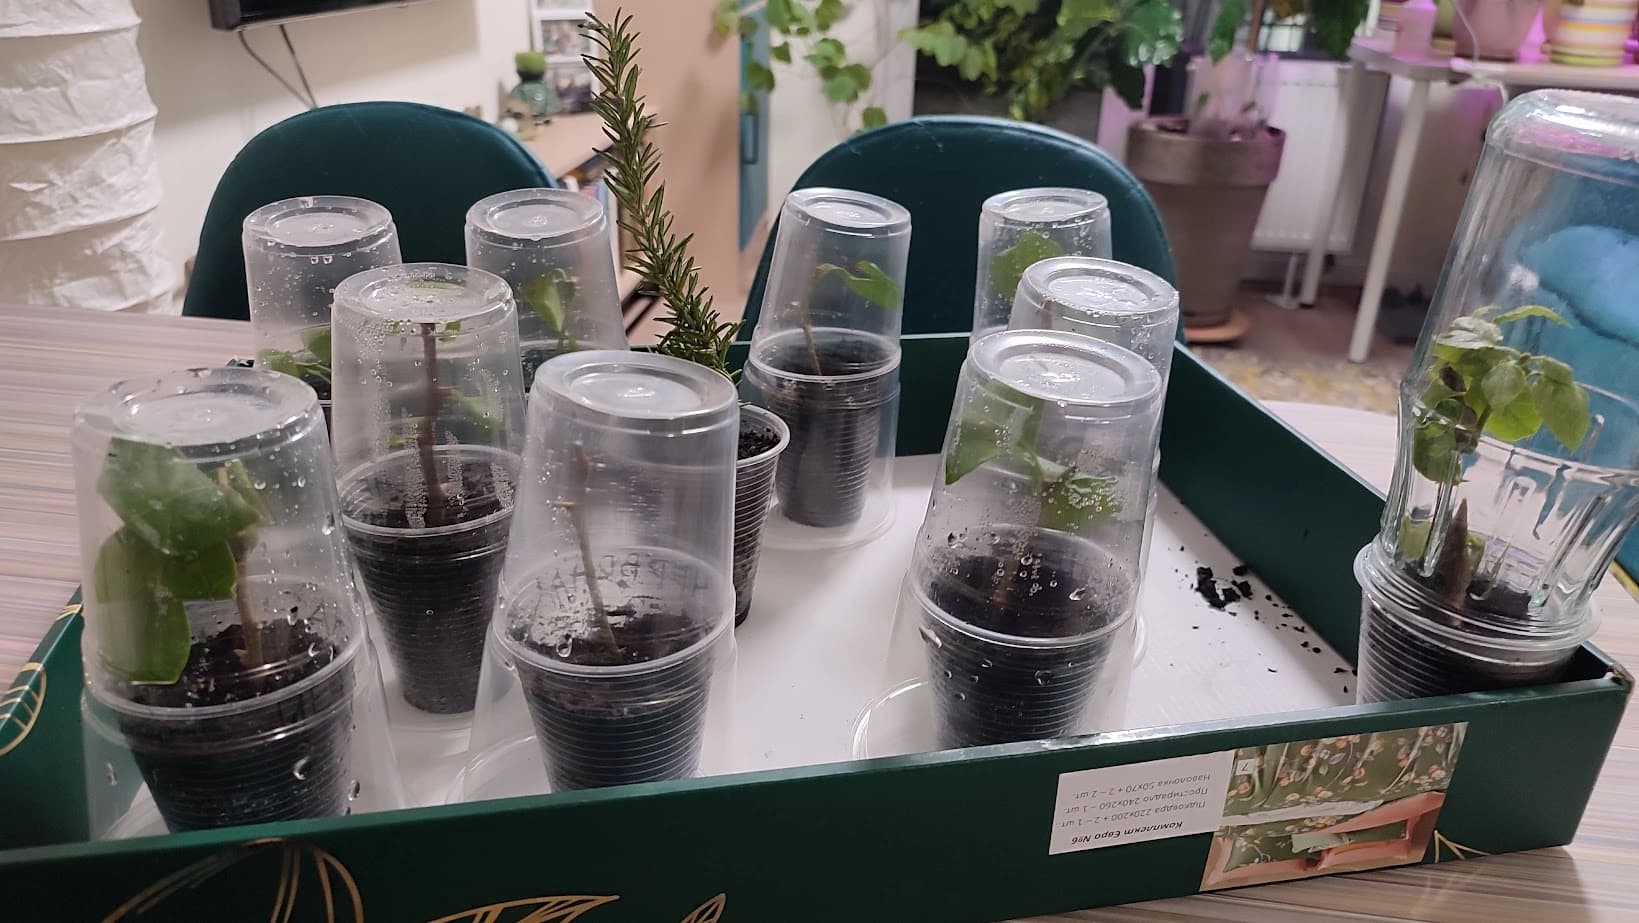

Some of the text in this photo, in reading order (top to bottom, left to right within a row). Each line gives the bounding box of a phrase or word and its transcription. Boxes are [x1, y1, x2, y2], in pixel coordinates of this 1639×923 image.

[1157, 774, 1211, 788] Наволочка
[1154, 801, 1206, 816] Підковдра
[1123, 821, 1184, 836] Комплект
[1070, 835, 1092, 845] №6
